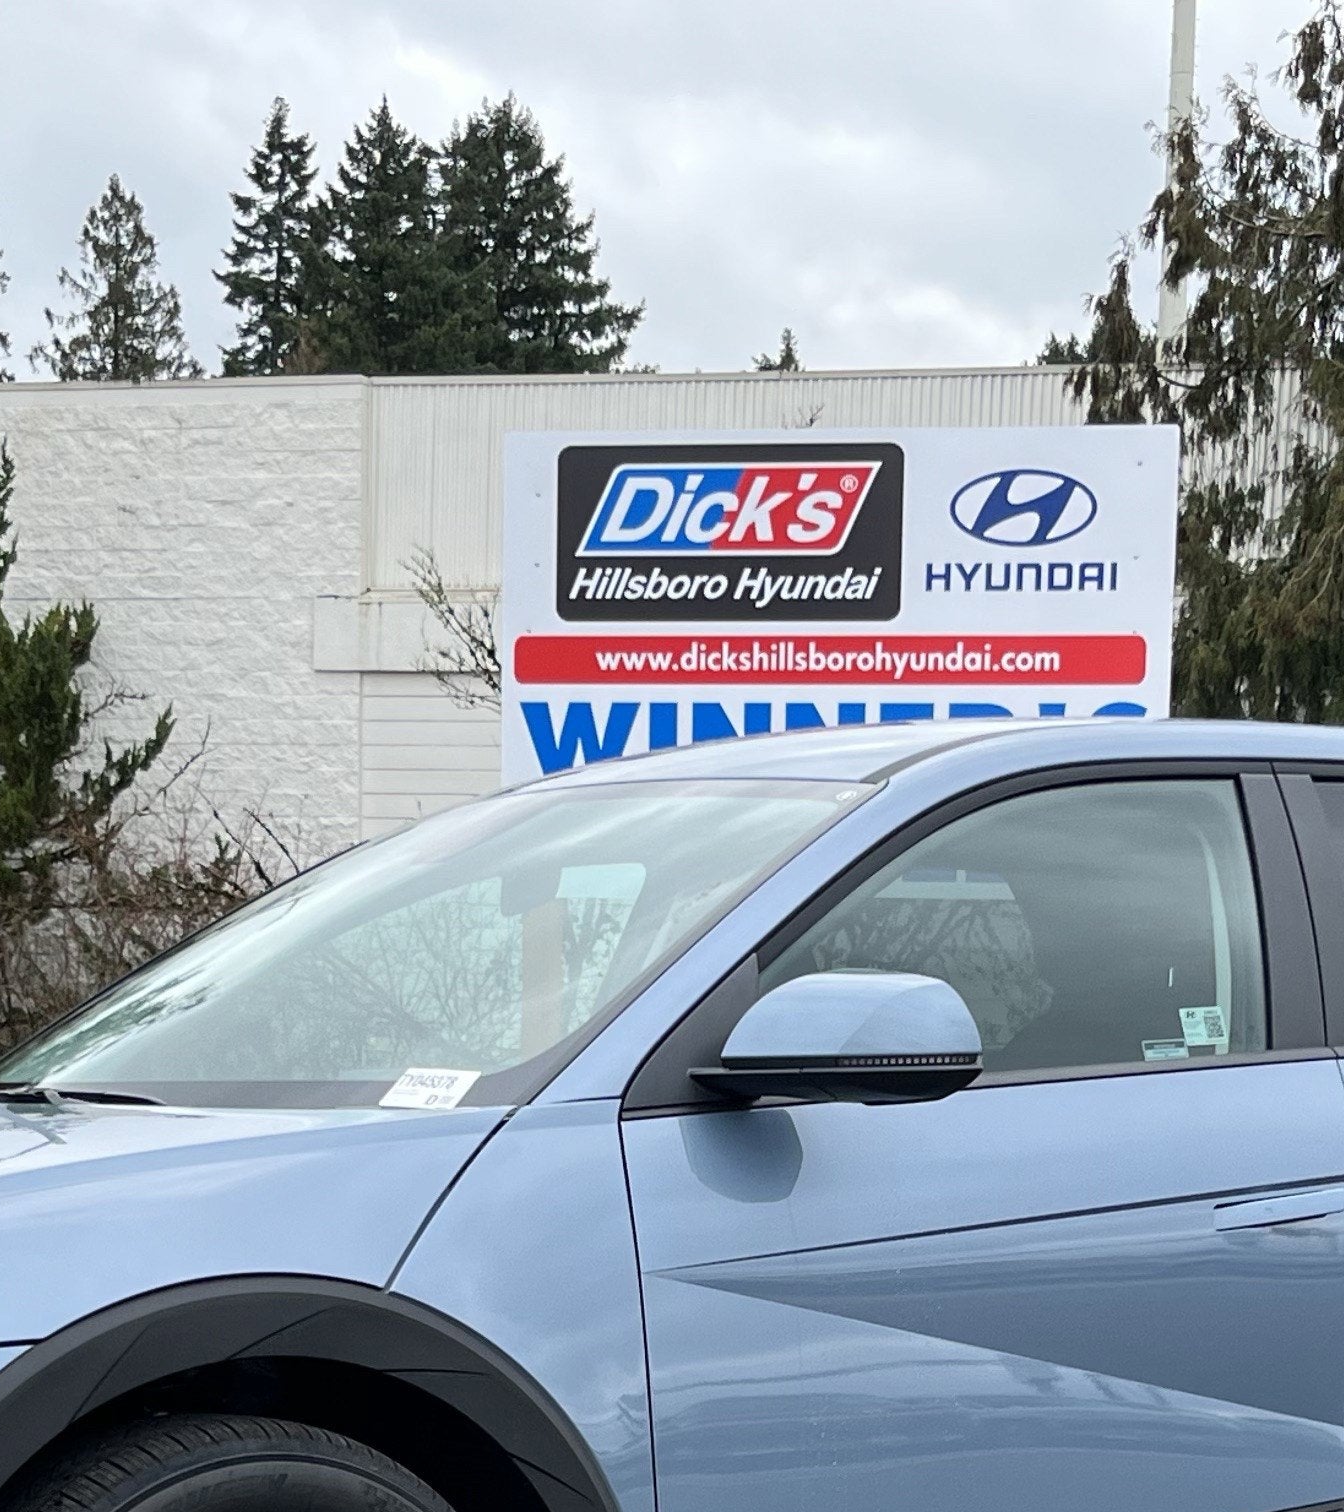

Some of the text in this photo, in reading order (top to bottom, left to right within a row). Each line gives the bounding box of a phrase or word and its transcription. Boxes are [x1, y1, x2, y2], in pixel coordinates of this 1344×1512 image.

[601, 472, 842, 545] Dick's
[568, 566, 883, 608] Hillsboro Hyundai
[925, 562, 1118, 592] HYUNDAI
[595, 640, 1061, 680] www.dickshillsborohyundai.com
